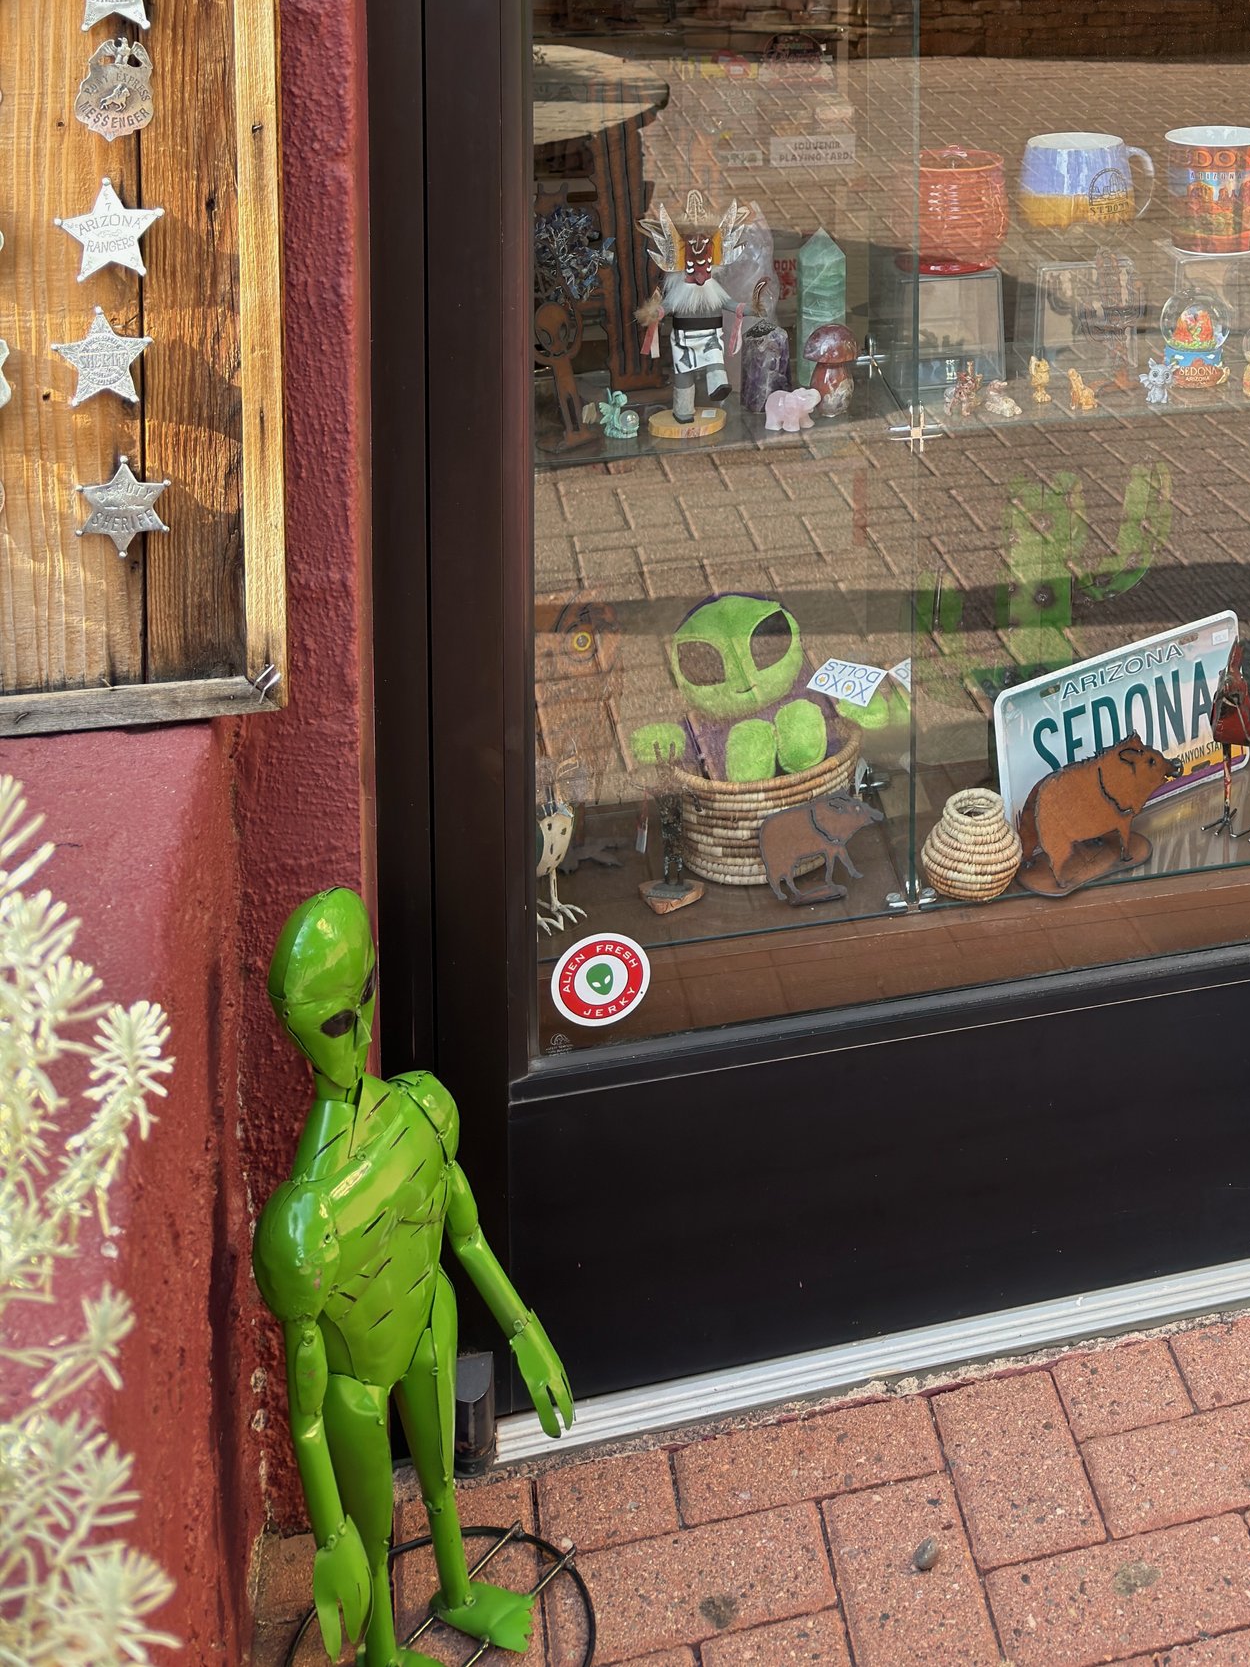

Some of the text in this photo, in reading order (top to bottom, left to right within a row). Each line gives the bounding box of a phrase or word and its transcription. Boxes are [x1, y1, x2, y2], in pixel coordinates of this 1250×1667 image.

[116, 72, 151, 103] EXPRESS
[78, 101, 150, 129] MESSENGER
[793, 141, 840, 151] SOUVENIR
[78, 213, 142, 236] ARIZONA
[85, 236, 136, 254] RANGERS
[1179, 366, 1218, 376] SEDONA
[92, 509, 154, 532] SHERIFF
[825, 662, 881, 683] DOLLS
[1062, 643, 1184, 700] ARIZONA
[815, 672, 873, 702] XOXO
[1033, 661, 1214, 772] SEDONA
[563, 944, 638, 993] ALIEN FRESH
[583, 987, 635, 1017] JERKY
